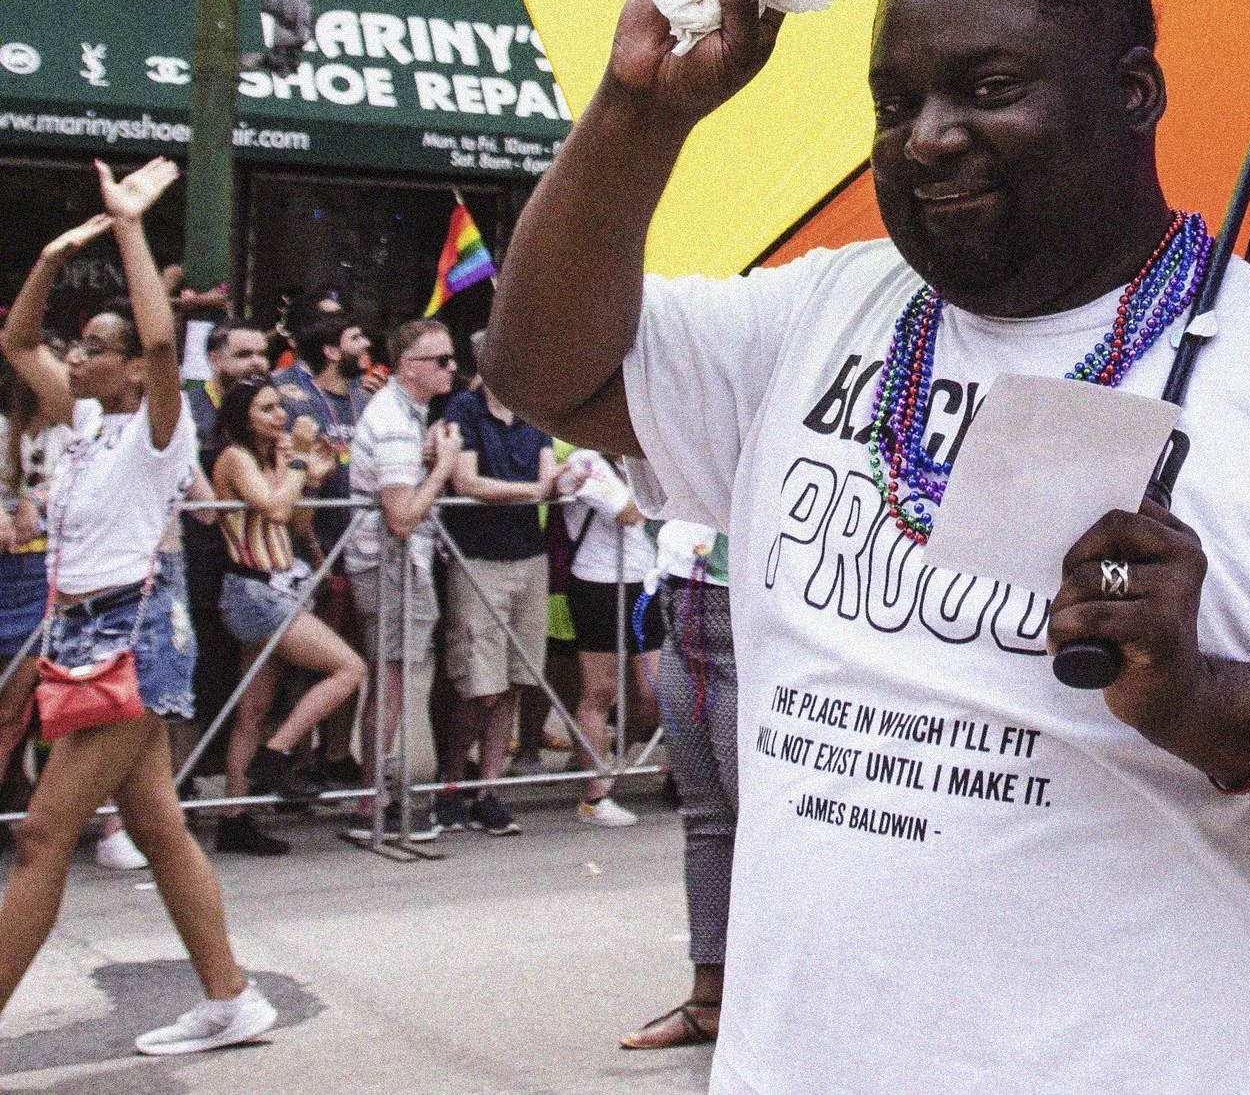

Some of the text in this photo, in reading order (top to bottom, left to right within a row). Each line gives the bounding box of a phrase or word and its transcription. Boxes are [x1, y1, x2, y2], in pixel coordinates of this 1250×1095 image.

[259, 10, 552, 73] ARINY'S
[238, 61, 573, 121] SHOE REPAI
[770, 686, 1041, 759] THE PLACE IN WHICH I'LL FIT
[756, 725, 1051, 808] WILL NOT EXIST UNTIL I MAKE IT.
[796, 794, 847, 827] JAMES
[849, 806, 929, 843] BALDWIN
